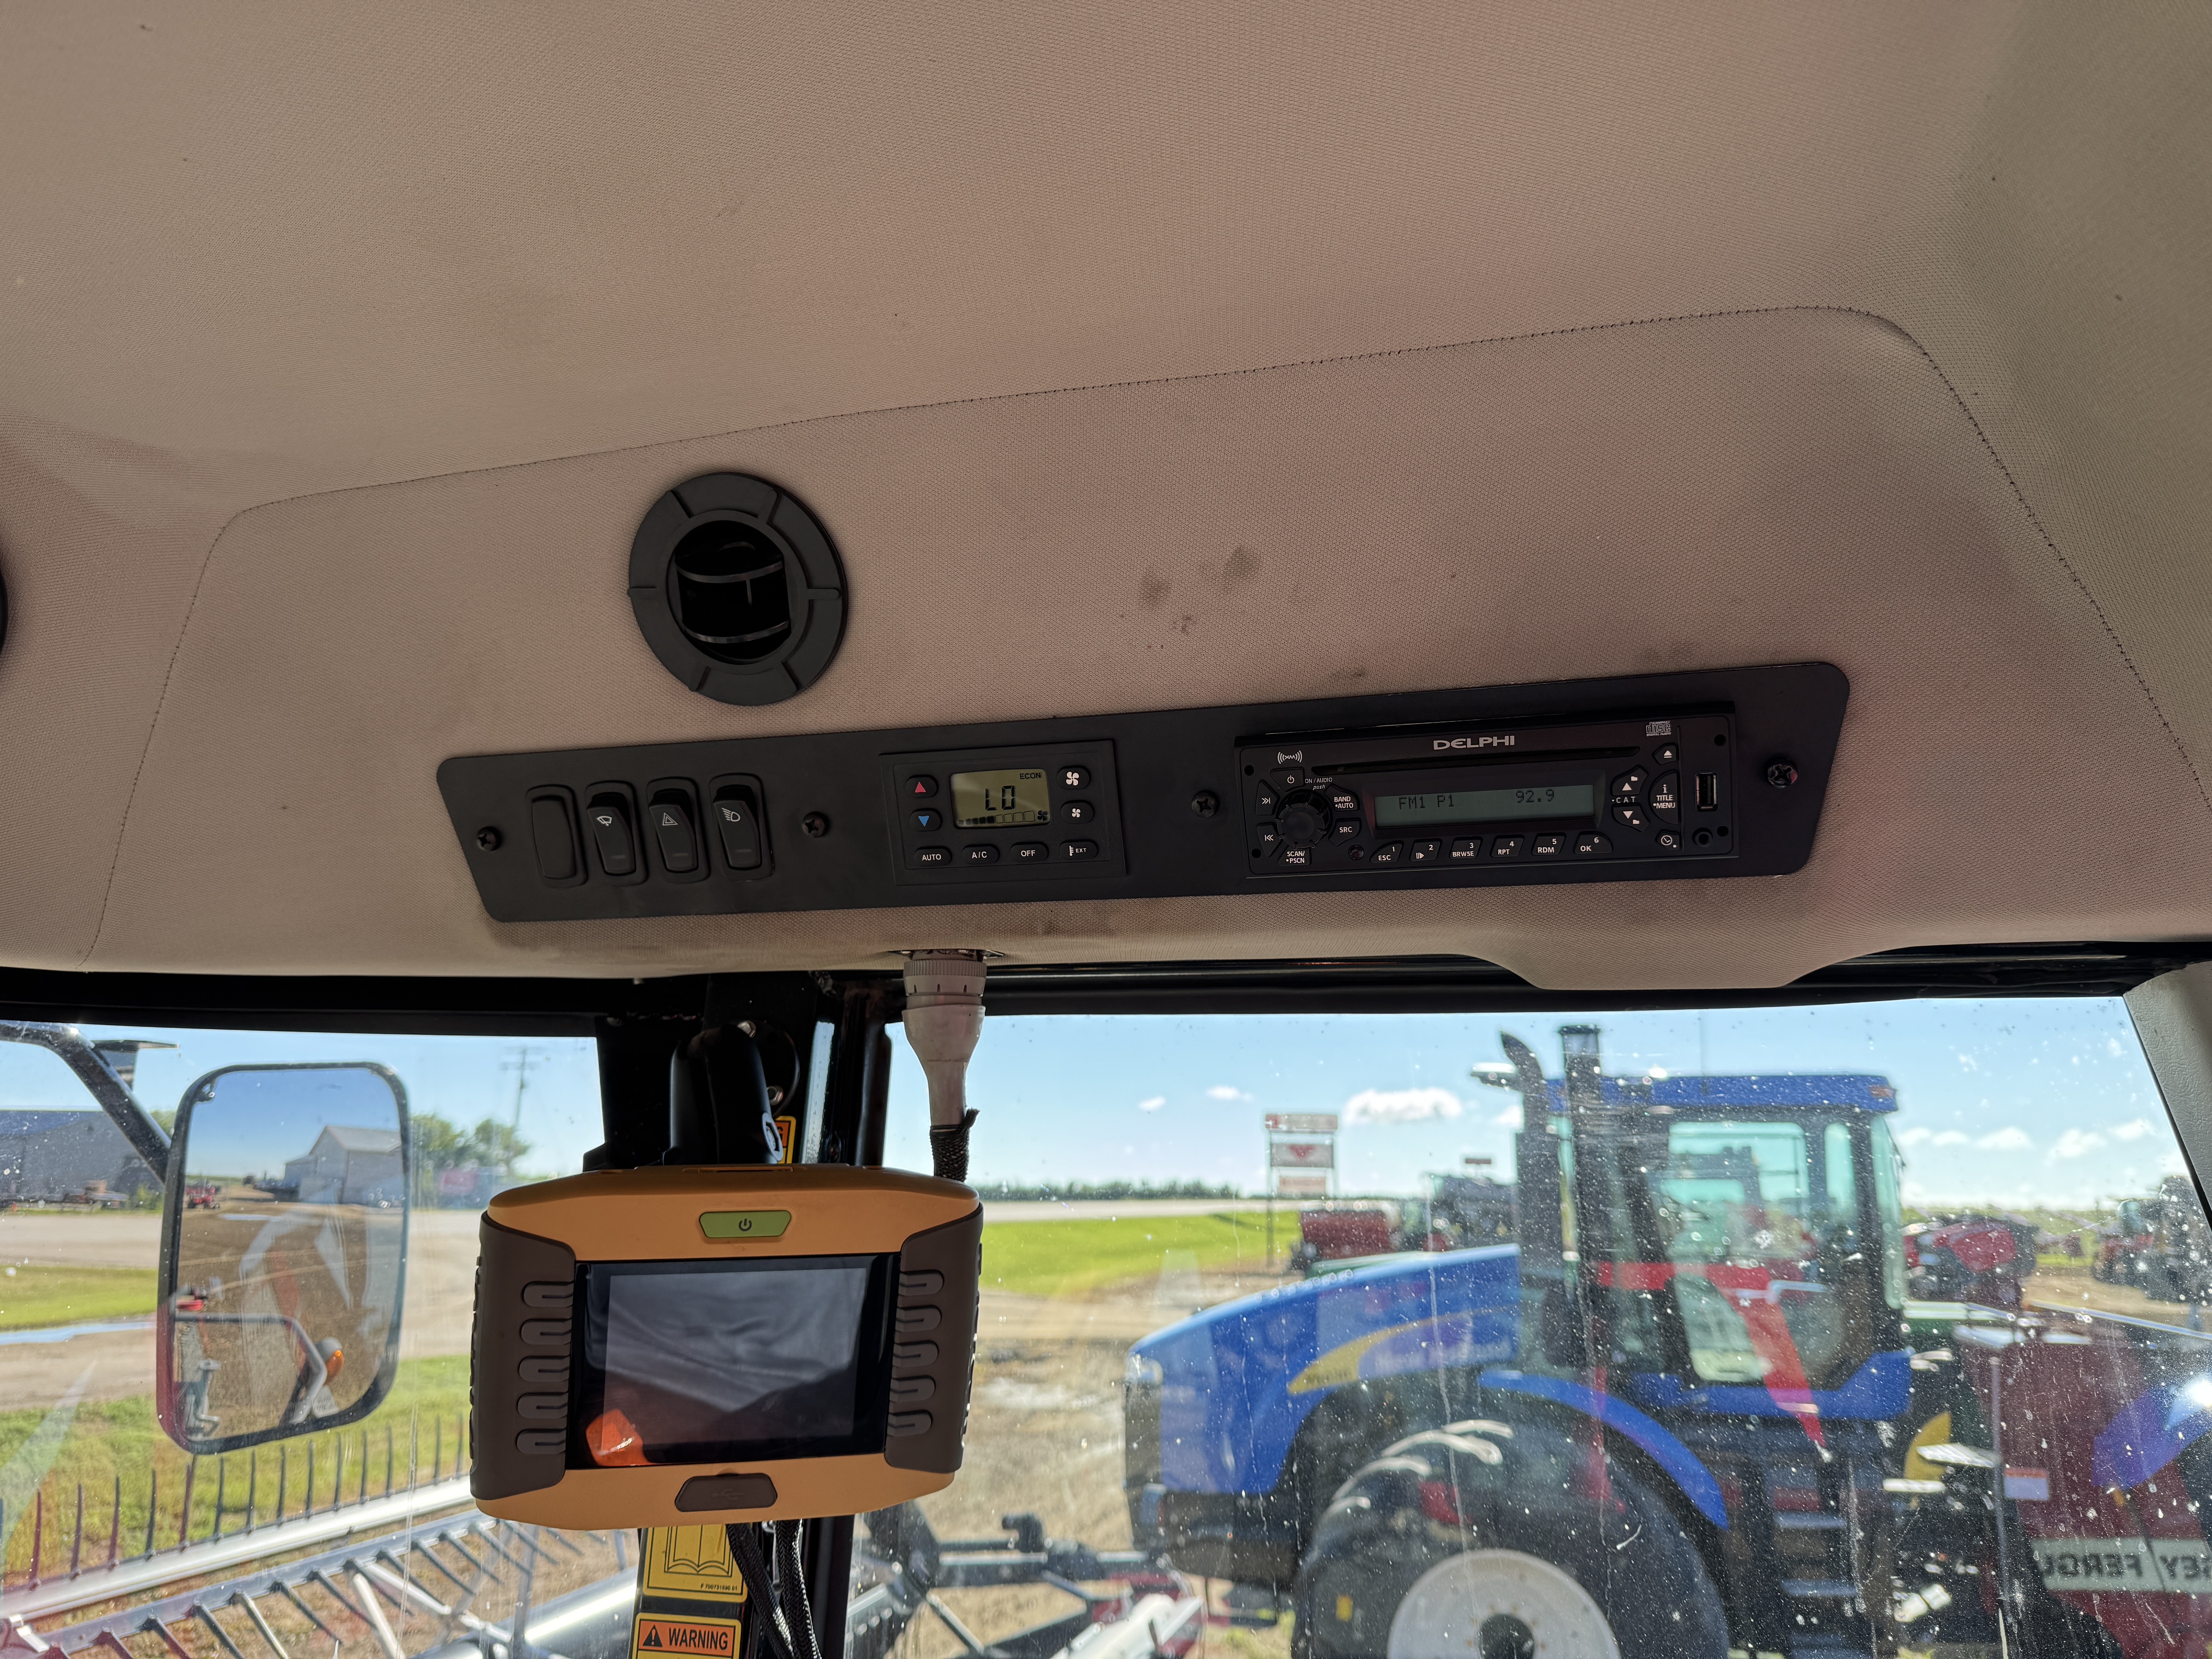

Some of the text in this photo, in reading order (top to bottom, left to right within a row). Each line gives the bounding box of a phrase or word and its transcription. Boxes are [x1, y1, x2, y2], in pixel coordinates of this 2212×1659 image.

[1433, 735, 1515, 750] DELPHI
[1399, 789, 1554, 810] FM1 P1 92.9
[669, 1627, 728, 1650] WARNING
